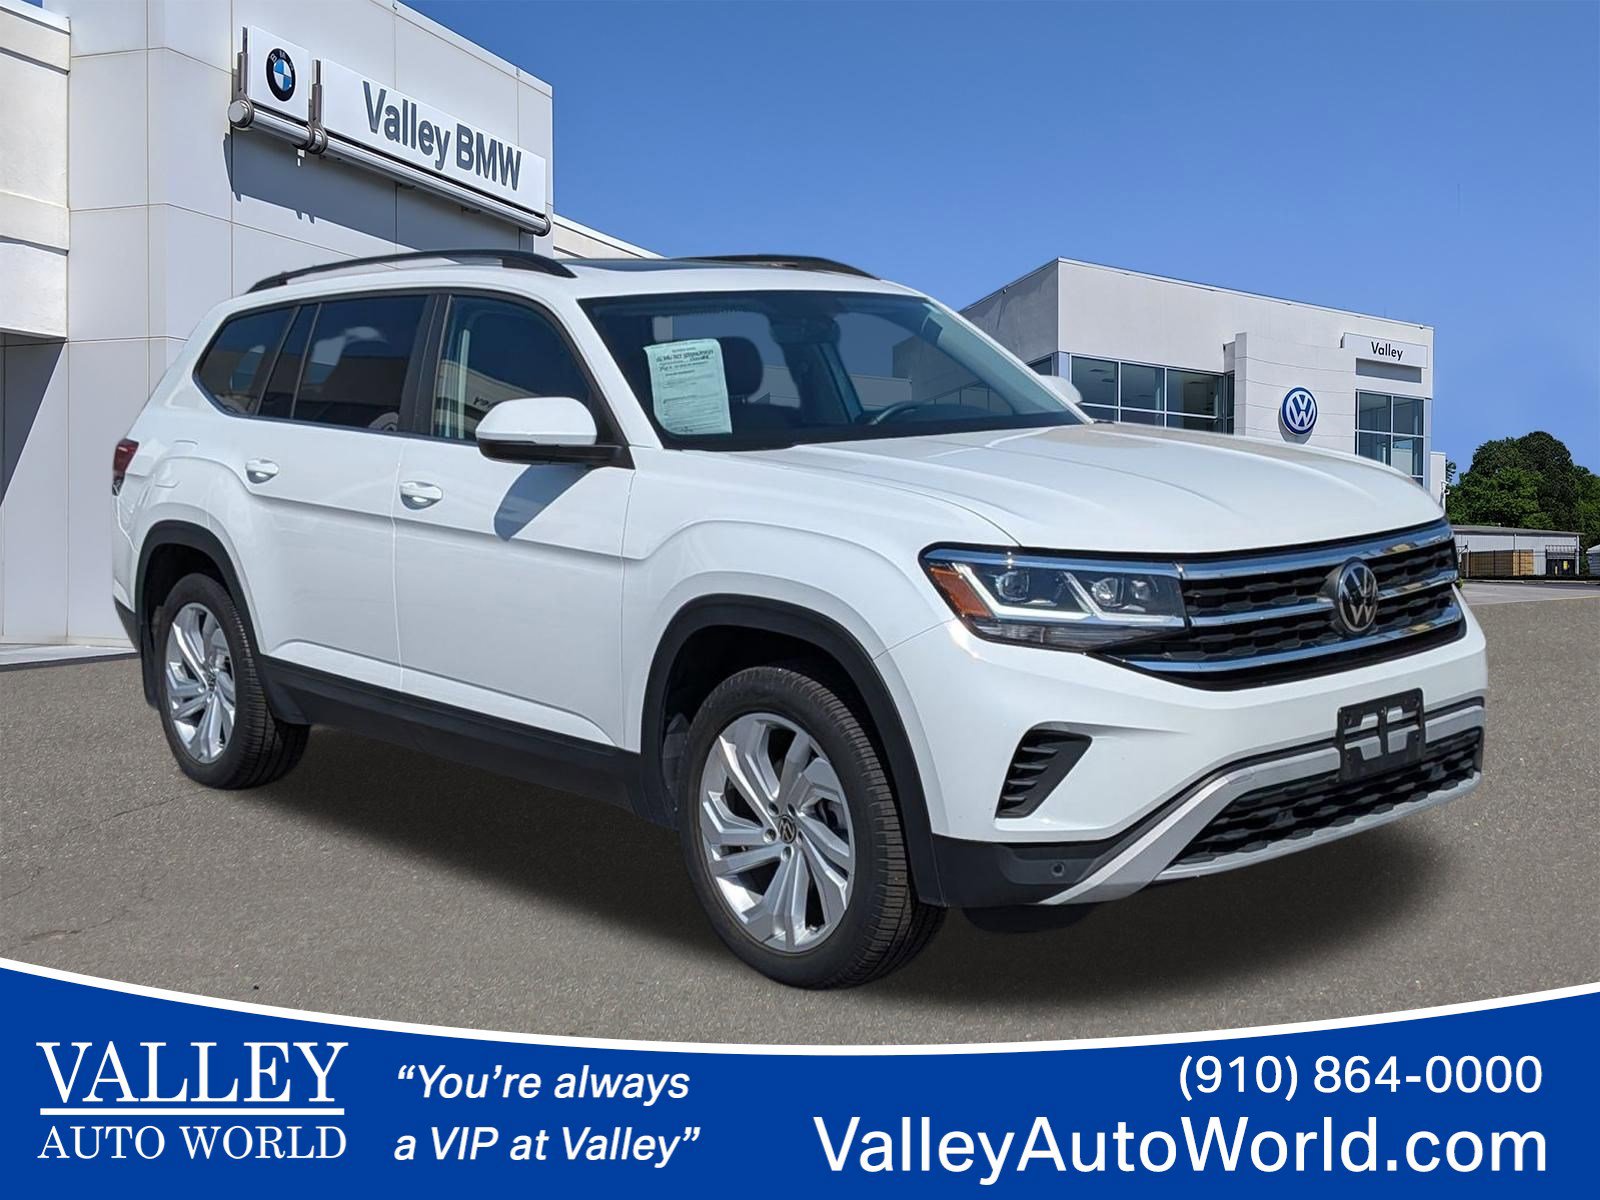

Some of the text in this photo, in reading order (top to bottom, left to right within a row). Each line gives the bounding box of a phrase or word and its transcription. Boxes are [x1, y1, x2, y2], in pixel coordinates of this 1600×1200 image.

[362, 80, 522, 191] Valley BMW
[1370, 341, 1404, 361] Valley
